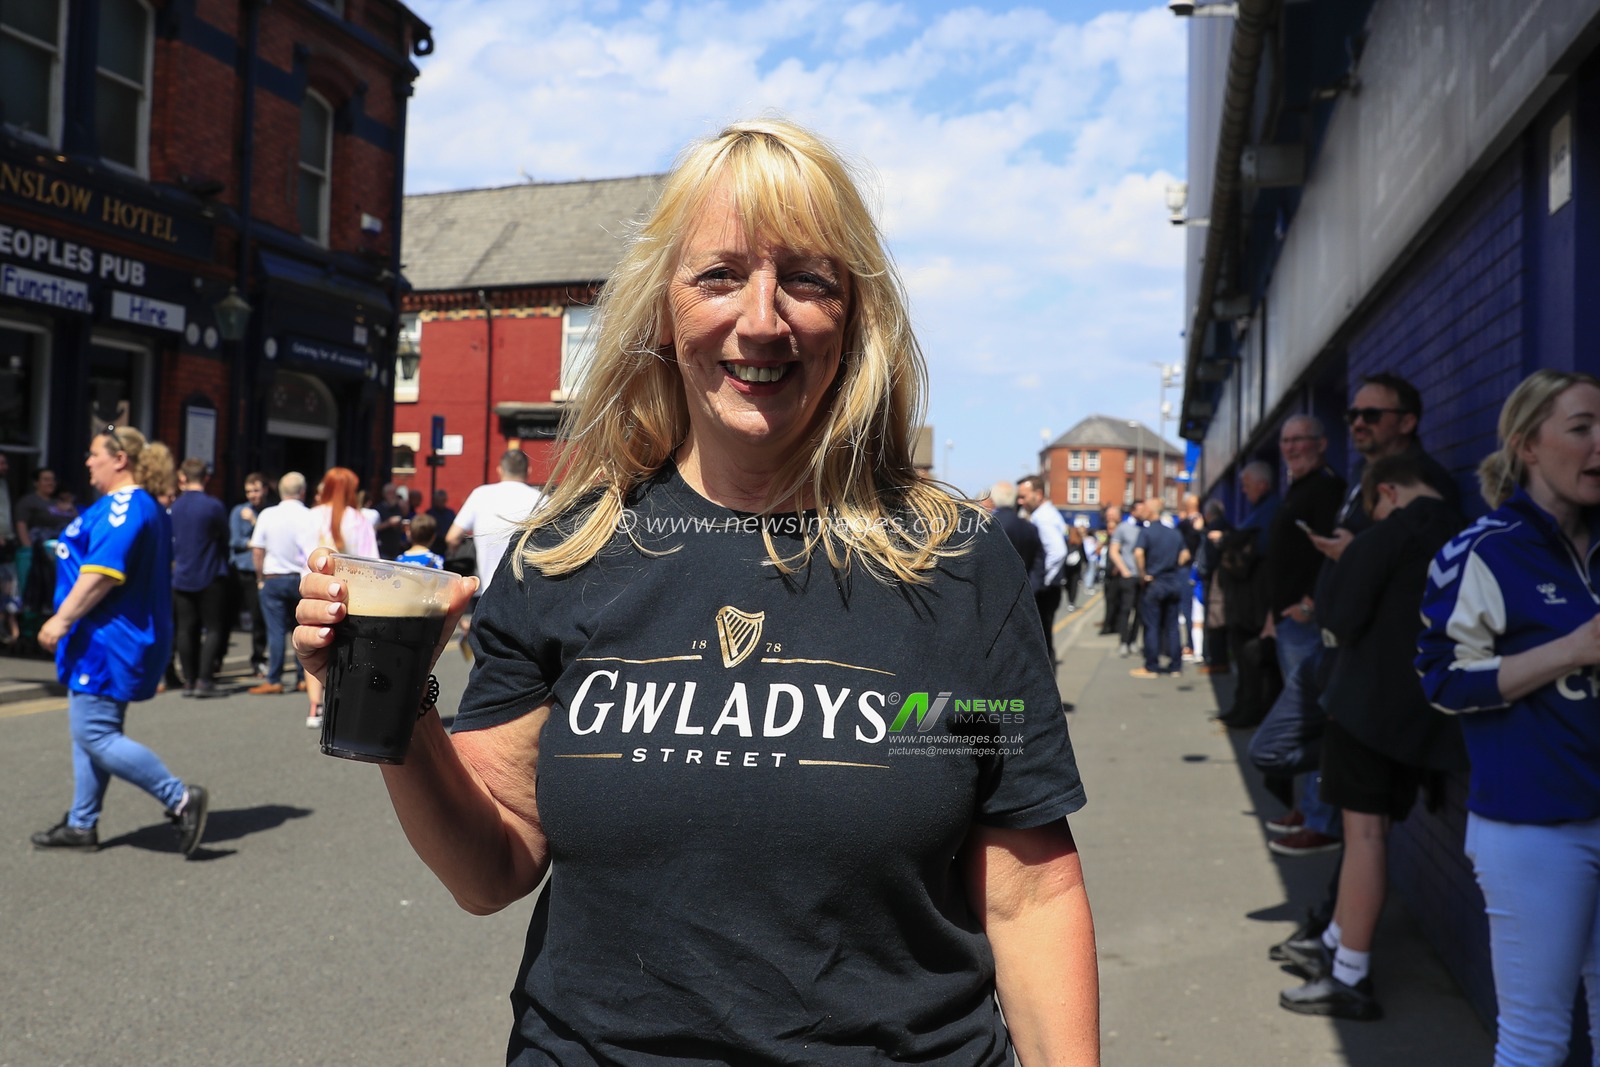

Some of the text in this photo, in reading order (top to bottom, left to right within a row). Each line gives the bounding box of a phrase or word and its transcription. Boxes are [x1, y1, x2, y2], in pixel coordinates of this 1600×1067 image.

[102, 194, 178, 243] HOTEL
[0, 223, 147, 287] EOPLES PUB
[4, 266, 169, 326] Function Hire
[691, 640, 781, 653] 18 78
[568, 669, 887, 744] GWLADYS
[632, 747, 787, 768] STREET
